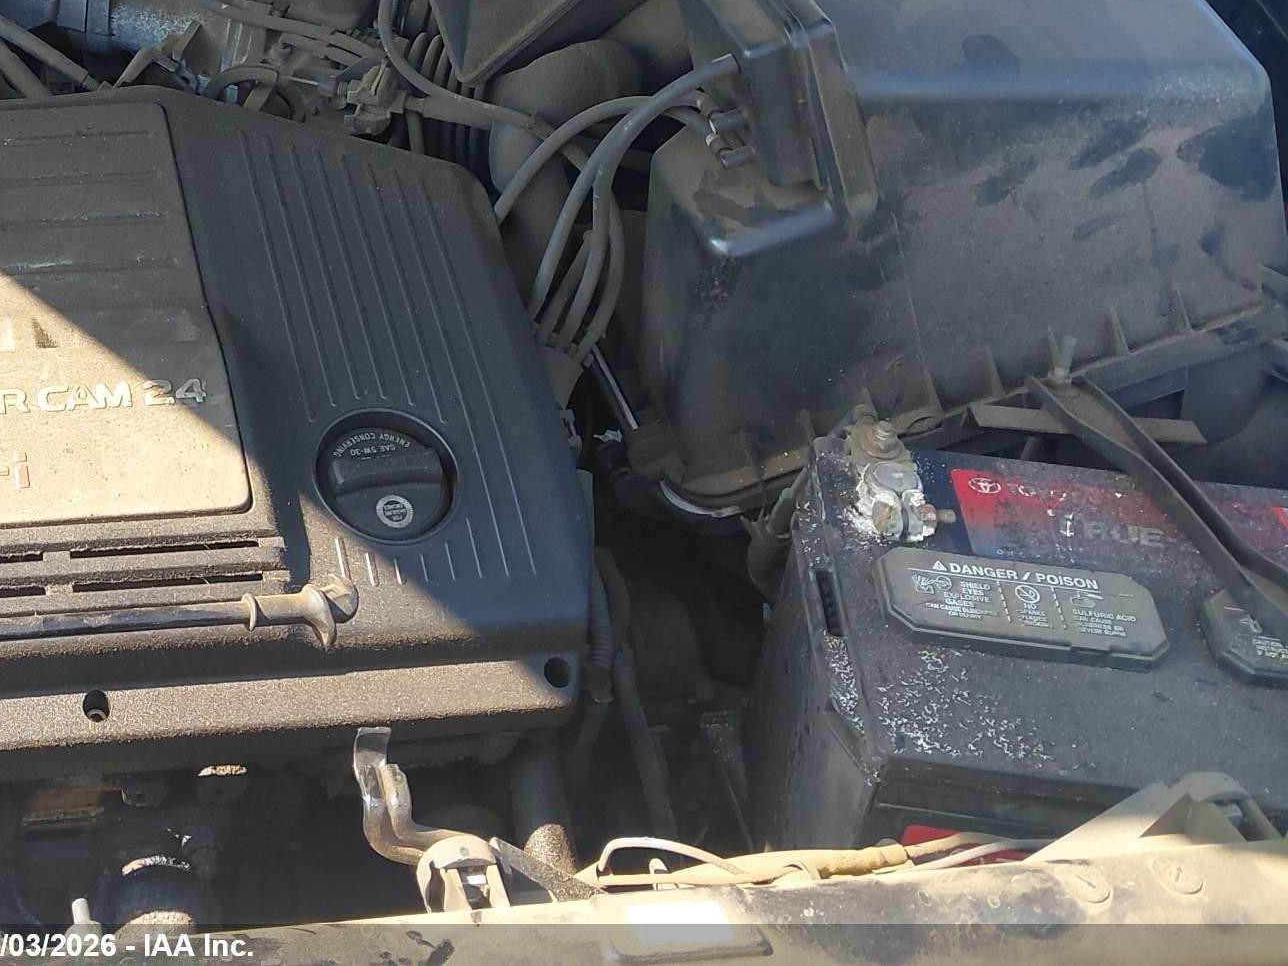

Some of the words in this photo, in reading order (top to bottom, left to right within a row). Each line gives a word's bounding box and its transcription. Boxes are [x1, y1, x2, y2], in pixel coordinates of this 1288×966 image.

[37, 380, 133, 412] CAM
[332, 432, 376, 458] CONSERVING
[379, 433, 411, 448] ENERGY
[949, 563, 1018, 580] DANGER
[1035, 573, 1099, 590] POISON
[960, 580, 991, 590] SHIELD
[943, 591, 991, 603] EXPLOSIVE
